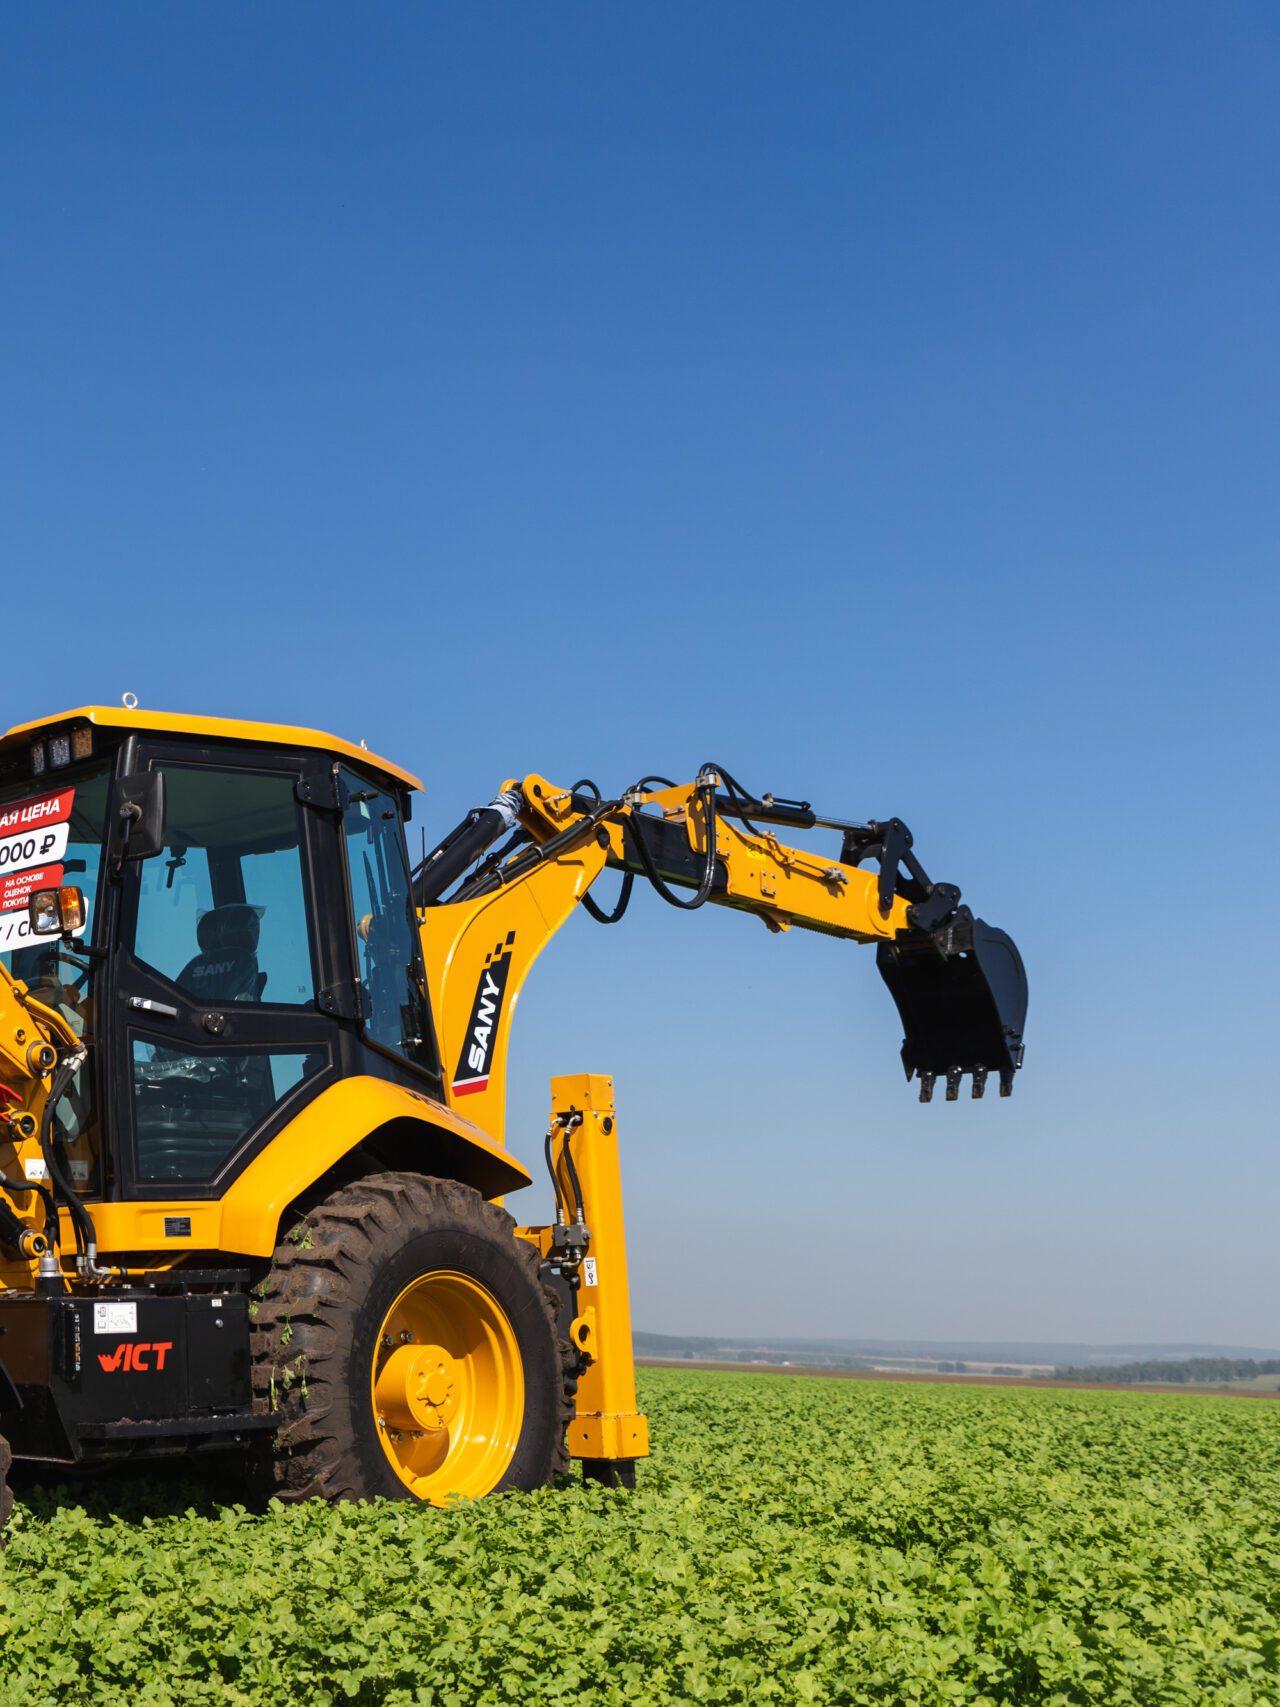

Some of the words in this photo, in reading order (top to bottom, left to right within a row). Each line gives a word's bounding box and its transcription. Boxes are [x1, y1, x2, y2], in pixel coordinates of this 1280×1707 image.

[21, 798, 60, 823] ЦЕНА
[16, 872, 45, 884] ОСНОВЕ
[4, 885, 32, 898] ОЦЕНОК
[2, 896, 30, 909] ПОКУПА
[192, 960, 236, 978] SANY
[468, 971, 500, 1074] SANY
